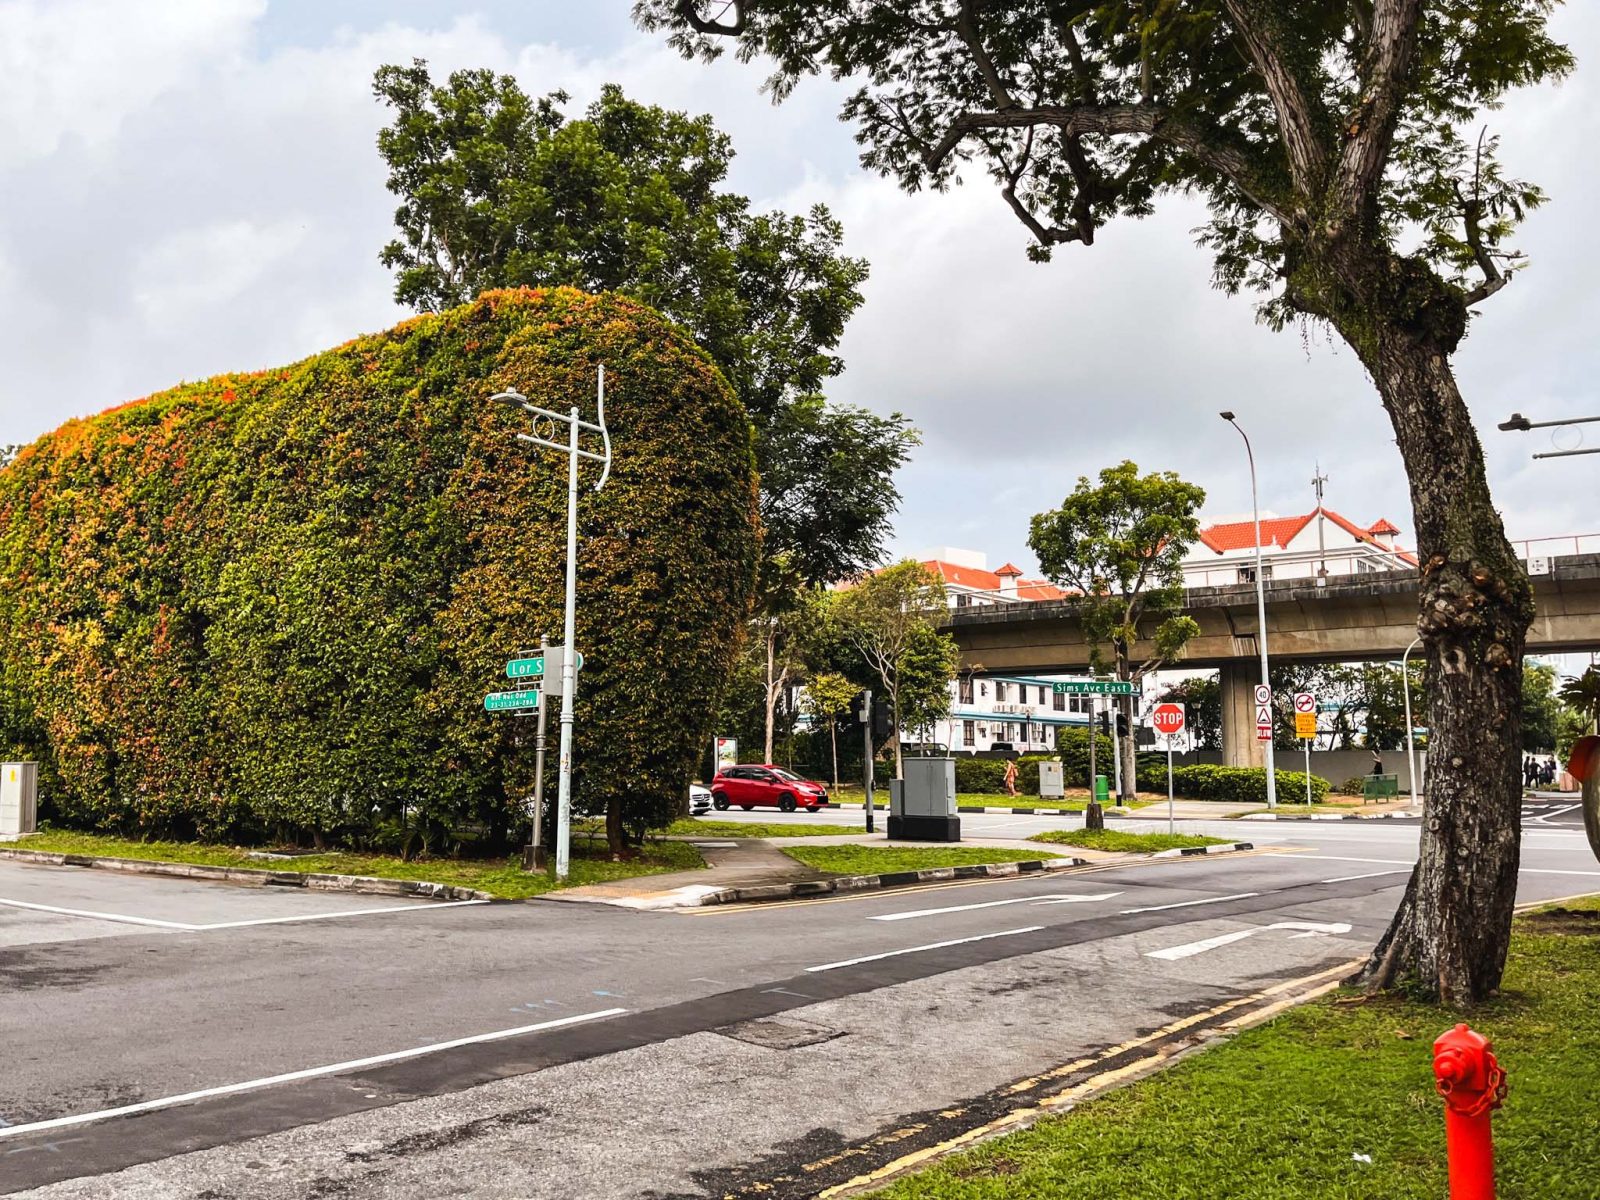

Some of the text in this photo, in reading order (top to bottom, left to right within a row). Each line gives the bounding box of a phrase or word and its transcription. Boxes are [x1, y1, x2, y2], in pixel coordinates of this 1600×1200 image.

[512, 662, 531, 675] Lor
[1056, 683, 1127, 692] Sims Ave East
[1259, 691, 1267, 699] 40
[1155, 712, 1183, 725] STOP
